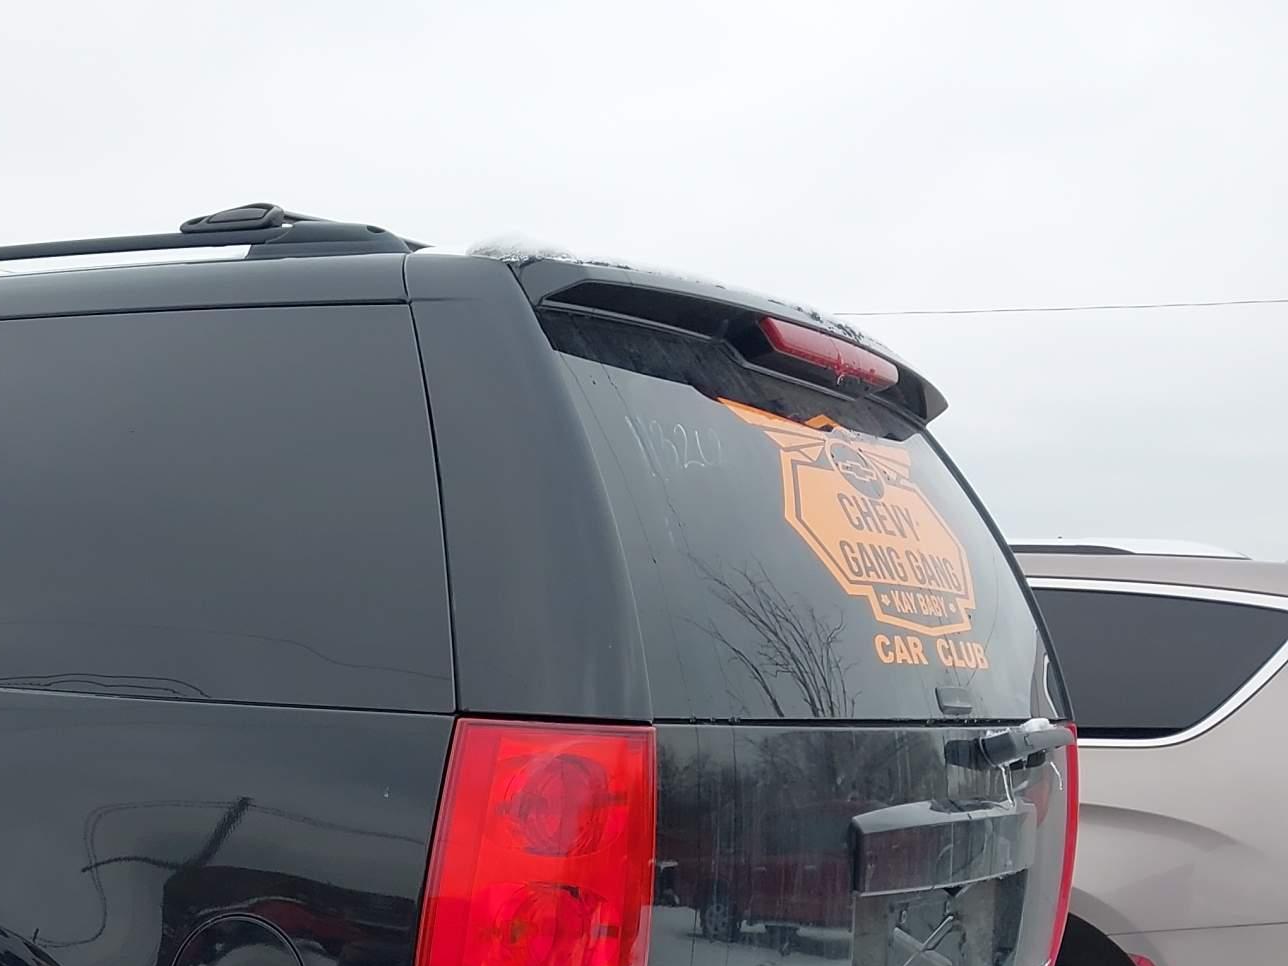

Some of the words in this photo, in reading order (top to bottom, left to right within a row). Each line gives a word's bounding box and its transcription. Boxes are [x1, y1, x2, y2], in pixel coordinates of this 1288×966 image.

[837, 492, 920, 542] CHEVY
[839, 539, 909, 582] GANG
[905, 549, 962, 592] GANG
[890, 590, 918, 615] KAY
[916, 592, 948, 618] BABY
[874, 634, 929, 665] CAR
[936, 638, 990, 669] CLUB
